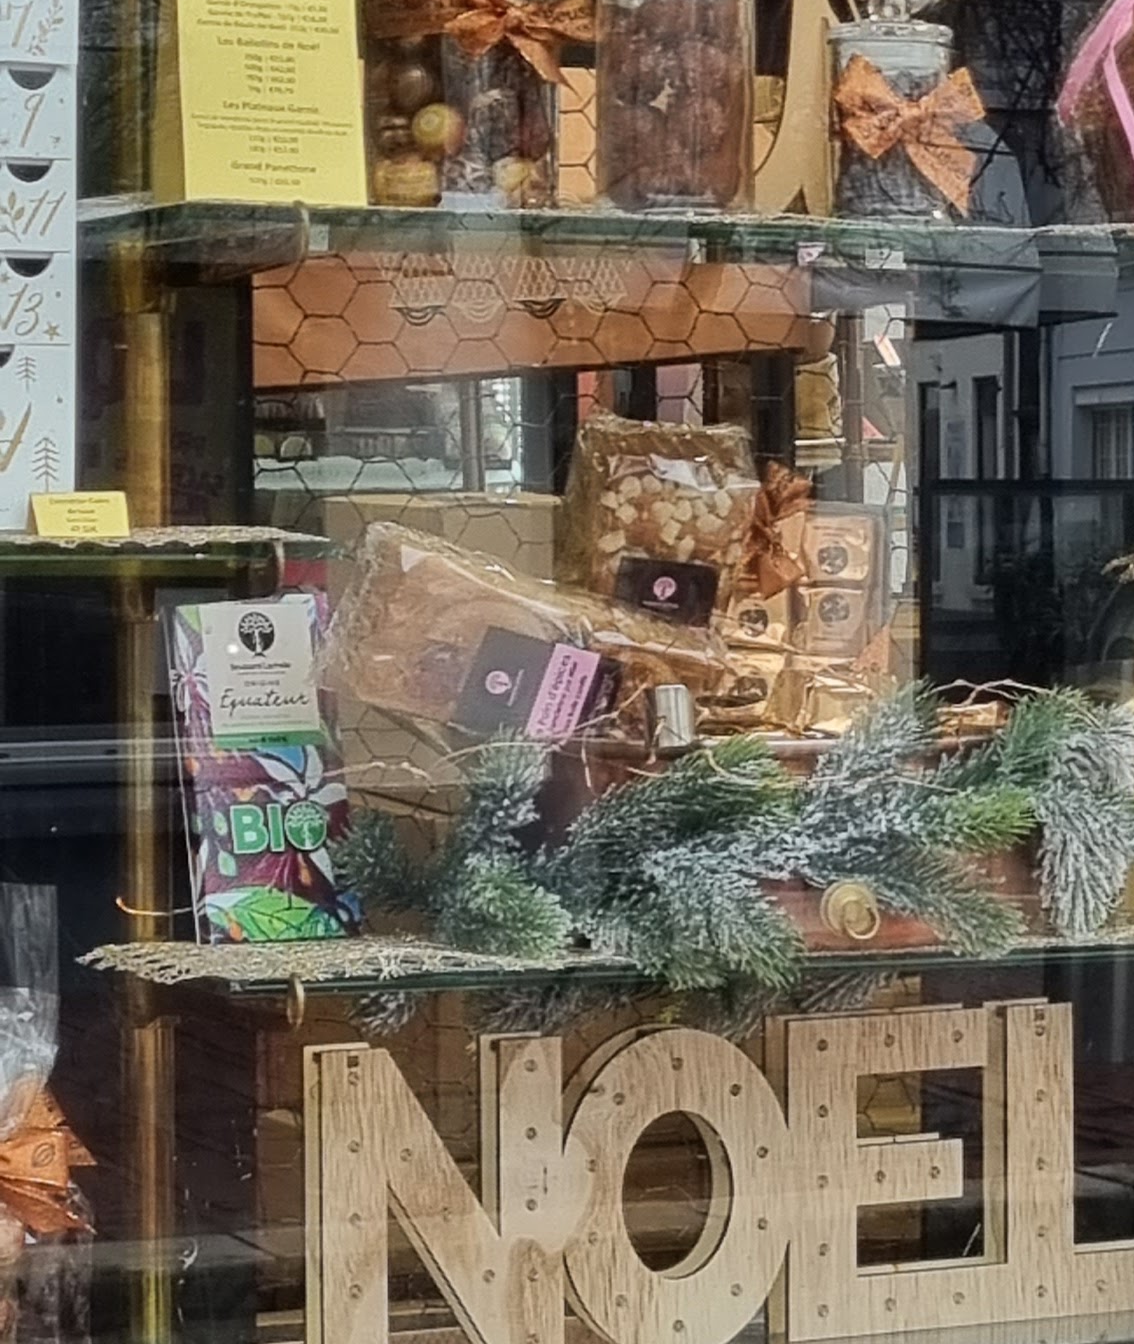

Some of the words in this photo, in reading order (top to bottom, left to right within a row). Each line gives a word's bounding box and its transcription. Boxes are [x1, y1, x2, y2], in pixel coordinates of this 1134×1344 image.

[21, 93, 45, 147] 9
[20, 189, 66, 236] 11
[0, 282, 43, 336] 13
